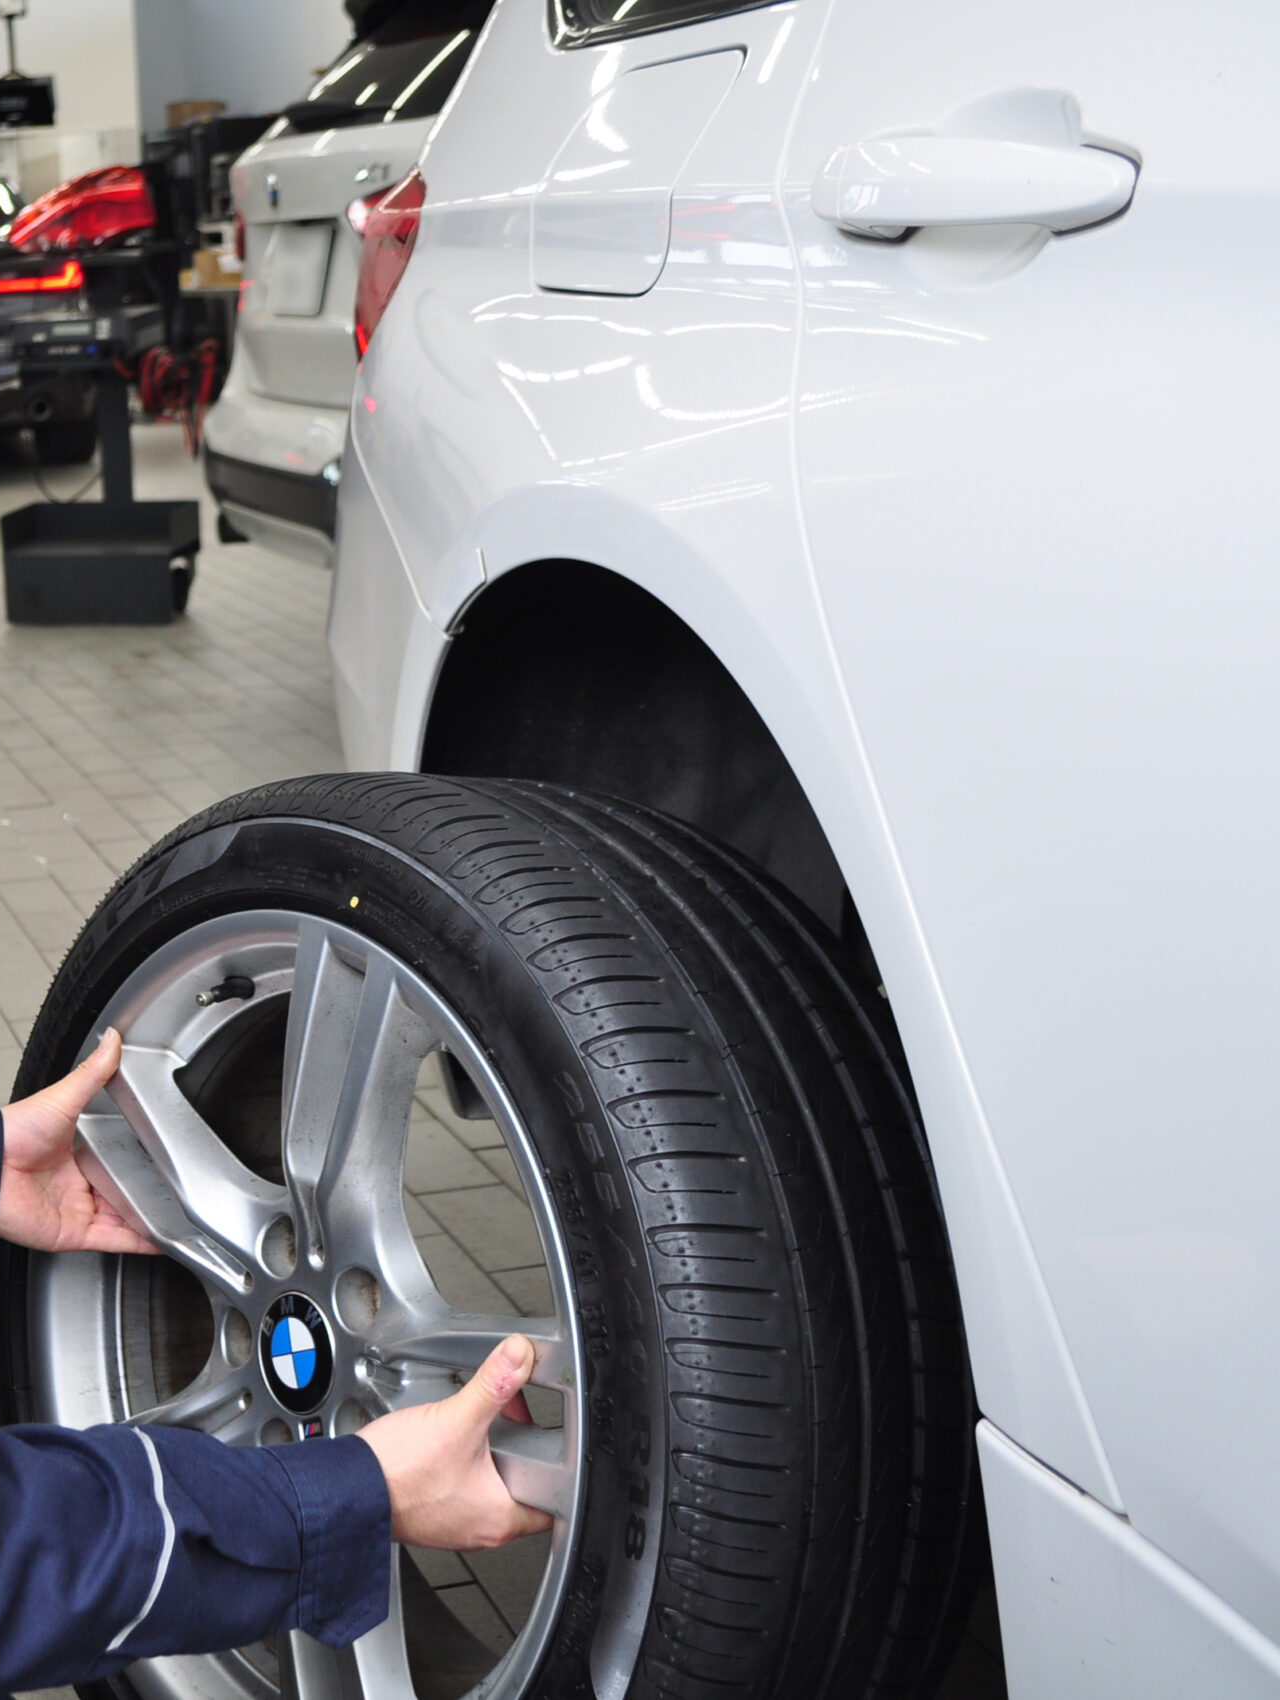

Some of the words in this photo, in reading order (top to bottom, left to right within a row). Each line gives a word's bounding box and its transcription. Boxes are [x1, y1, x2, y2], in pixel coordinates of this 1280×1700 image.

[106, 848, 180, 932] P7
[262, 1295, 322, 1337] BMW
[622, 1412, 653, 1561] R18
